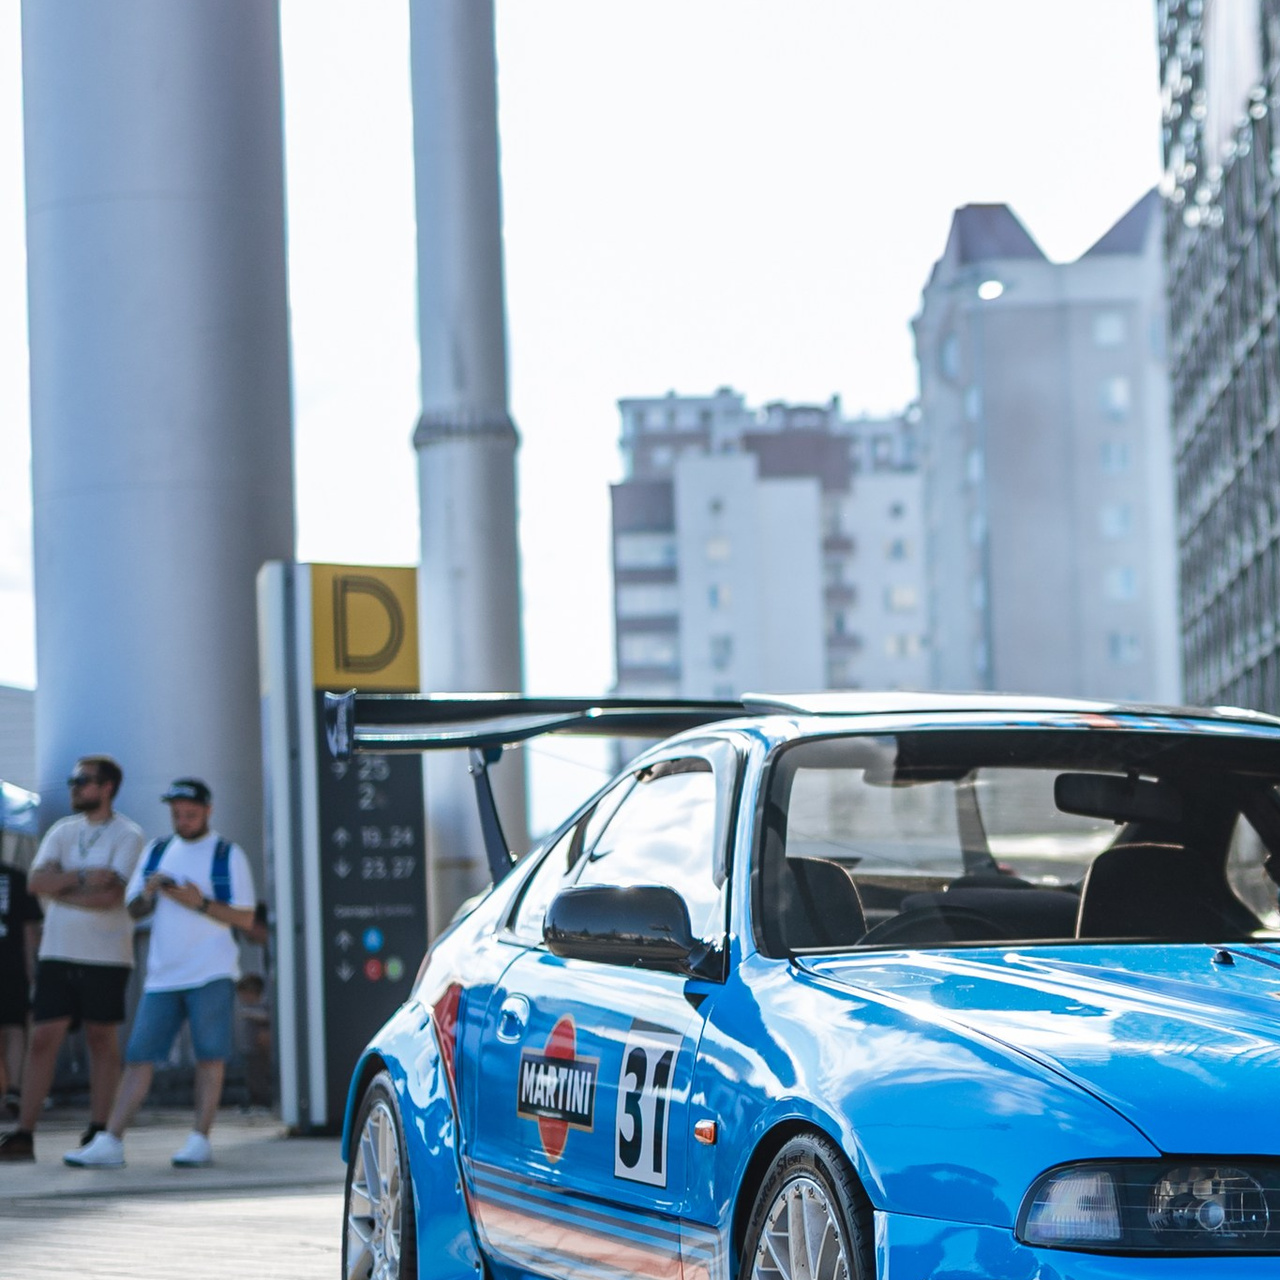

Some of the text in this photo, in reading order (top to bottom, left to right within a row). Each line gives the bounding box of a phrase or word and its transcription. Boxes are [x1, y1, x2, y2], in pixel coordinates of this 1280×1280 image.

[333, 575, 405, 673] D
[521, 1061, 592, 1116] MARTINI
[619, 1046, 675, 1174] 31
